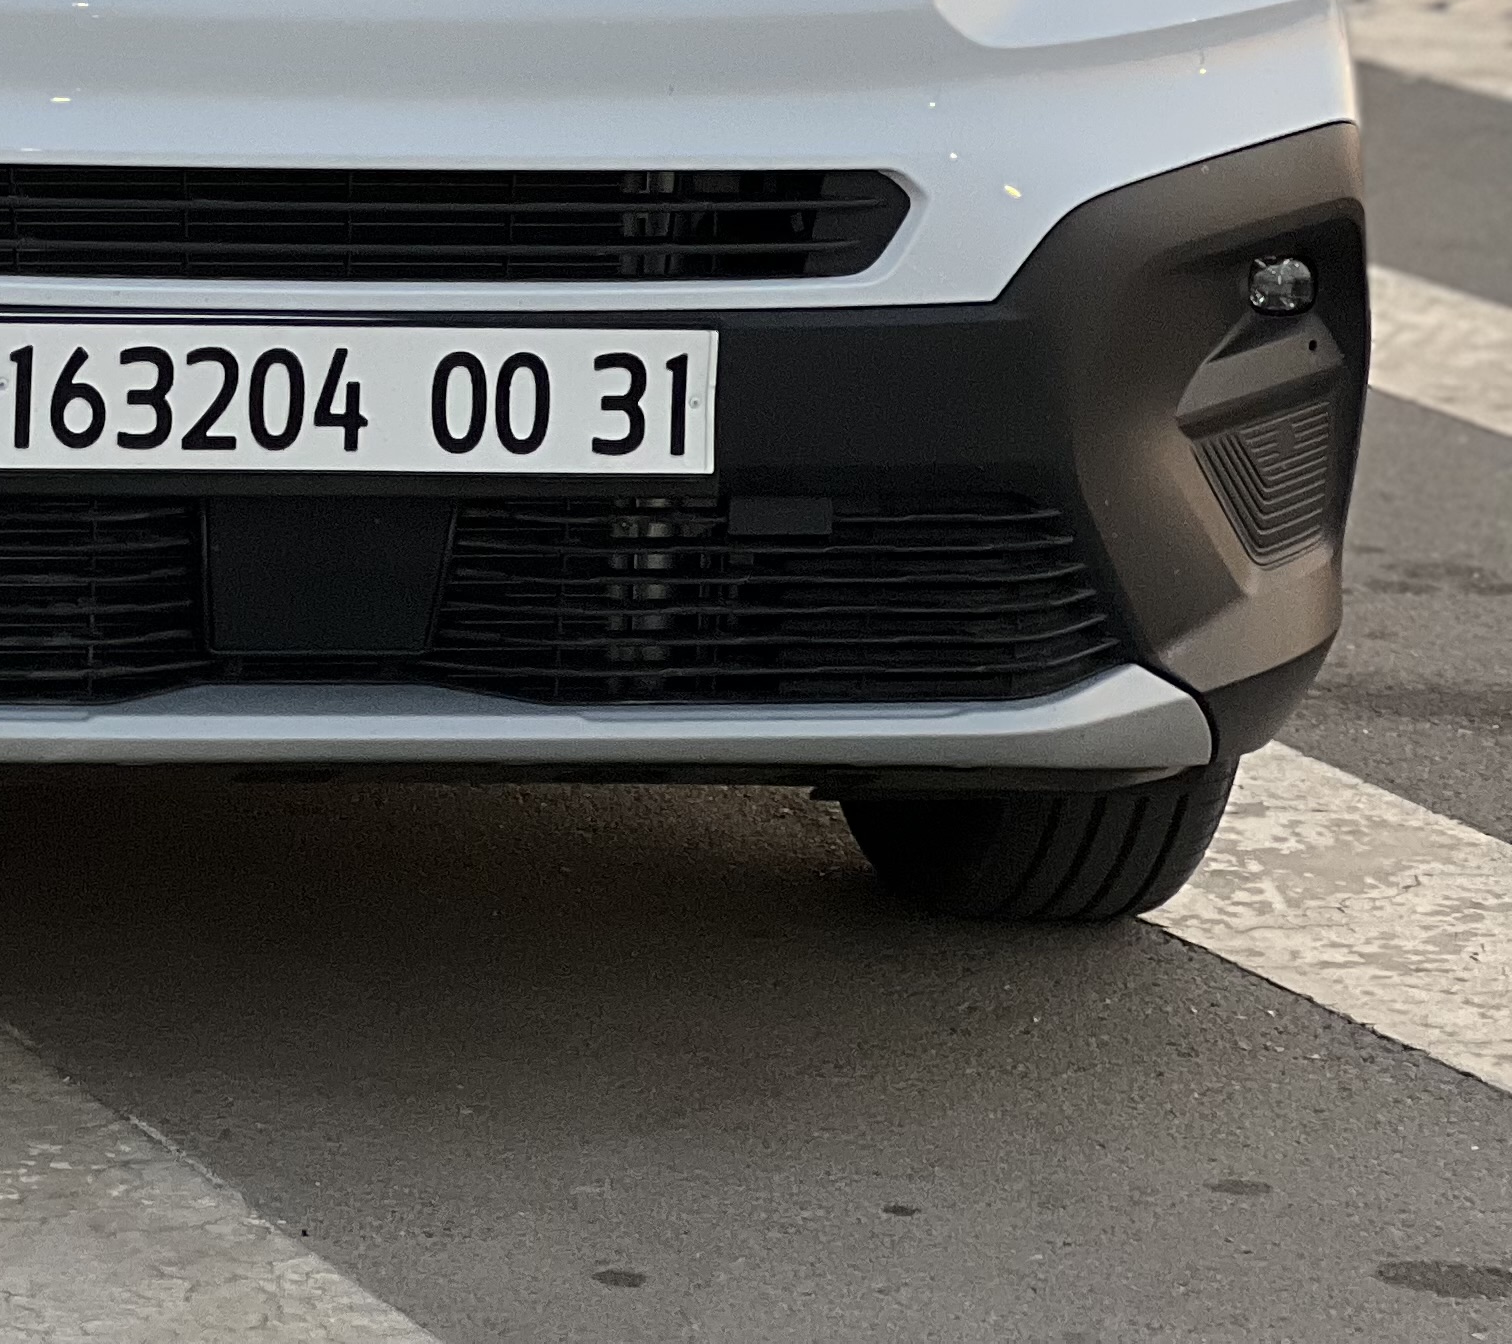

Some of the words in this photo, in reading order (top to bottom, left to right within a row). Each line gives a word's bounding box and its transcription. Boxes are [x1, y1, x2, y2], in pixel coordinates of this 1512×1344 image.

[8, 344, 370, 452] 163204
[430, 350, 552, 456] 00
[590, 351, 690, 457] 31
